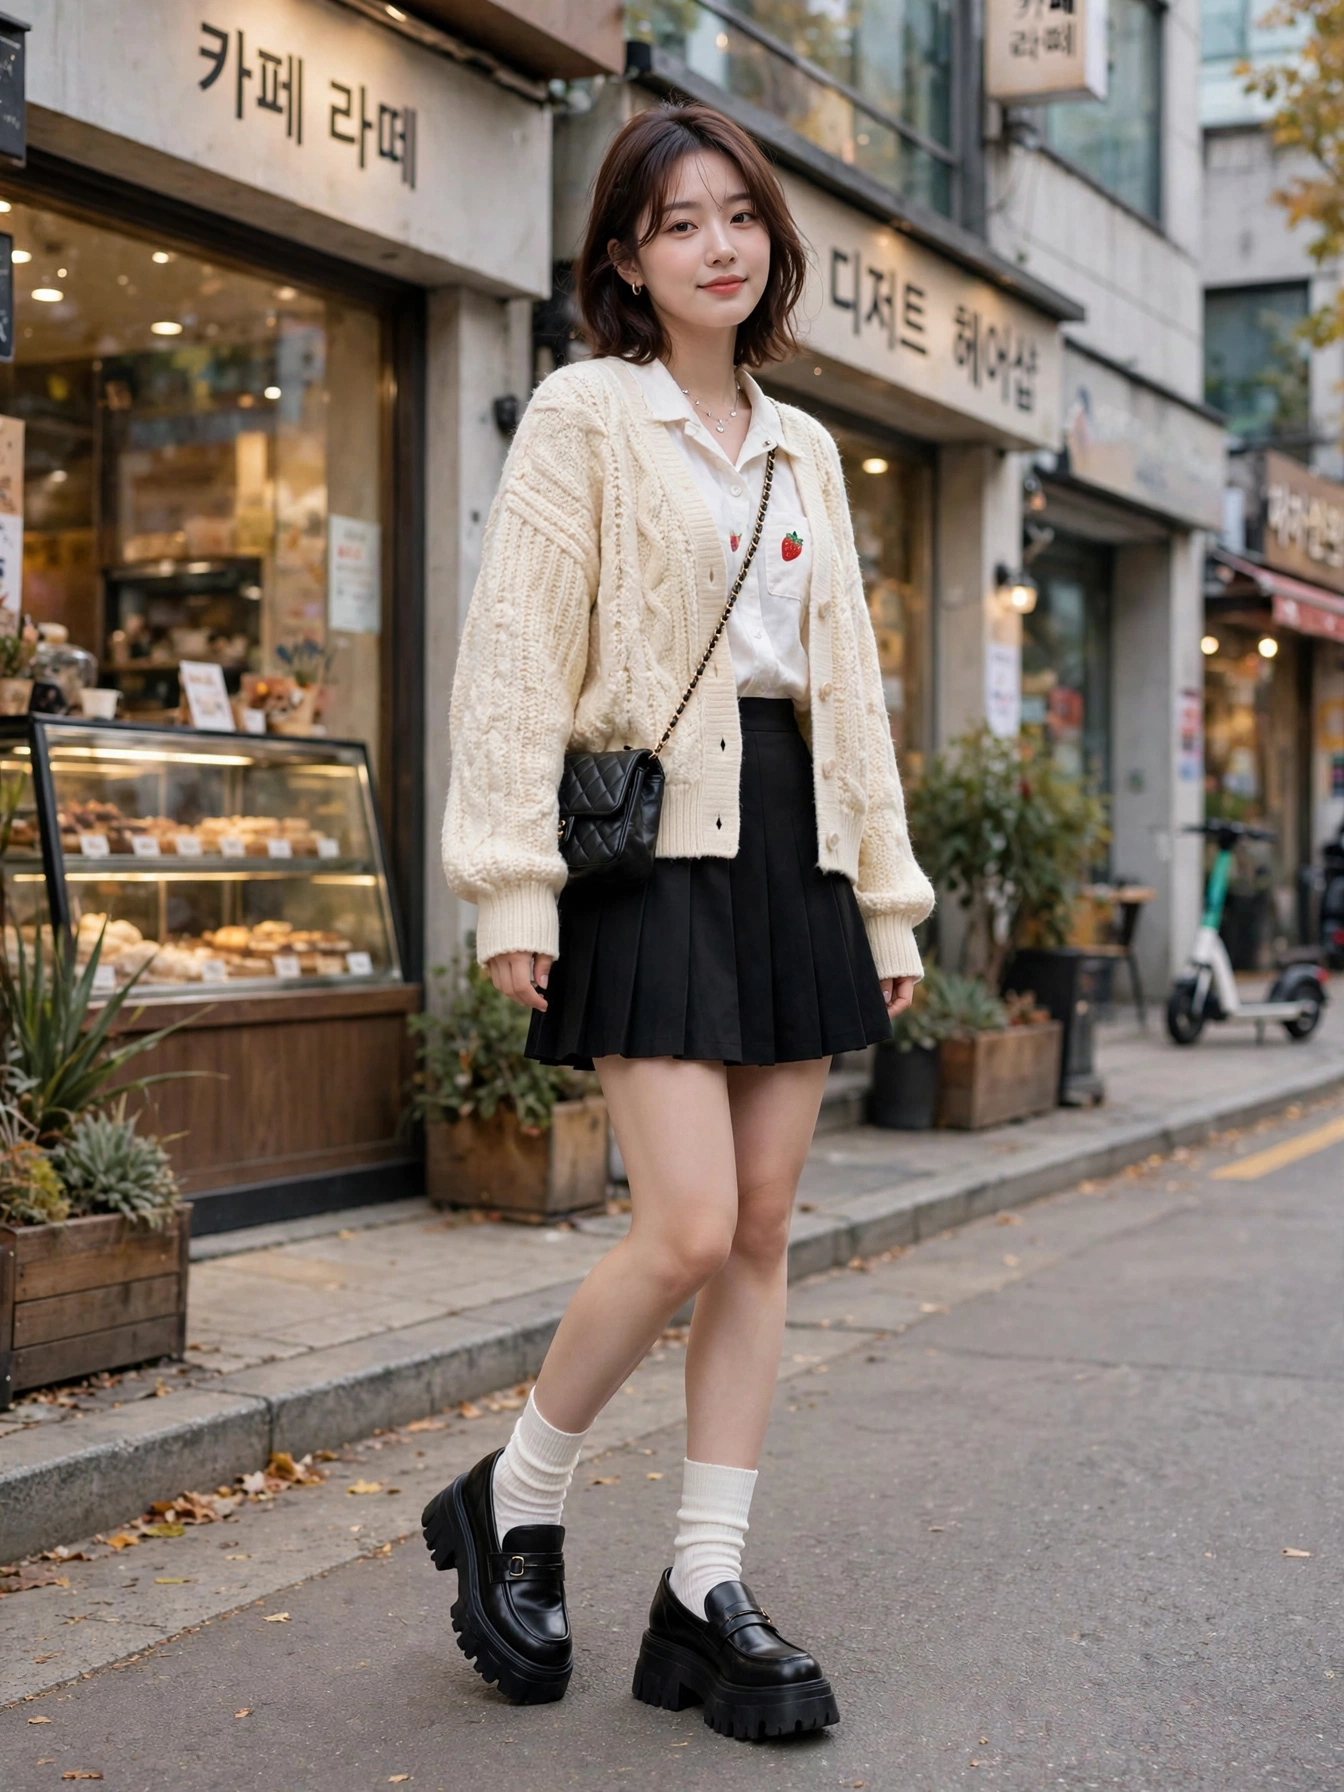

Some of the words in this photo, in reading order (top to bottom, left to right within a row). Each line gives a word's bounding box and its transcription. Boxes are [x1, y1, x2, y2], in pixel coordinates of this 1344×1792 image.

[198, 21, 303, 146] 카페
[329, 80, 417, 191] 라떼
[832, 248, 927, 356] 디저트
[954, 304, 1037, 414] 헤어샵
